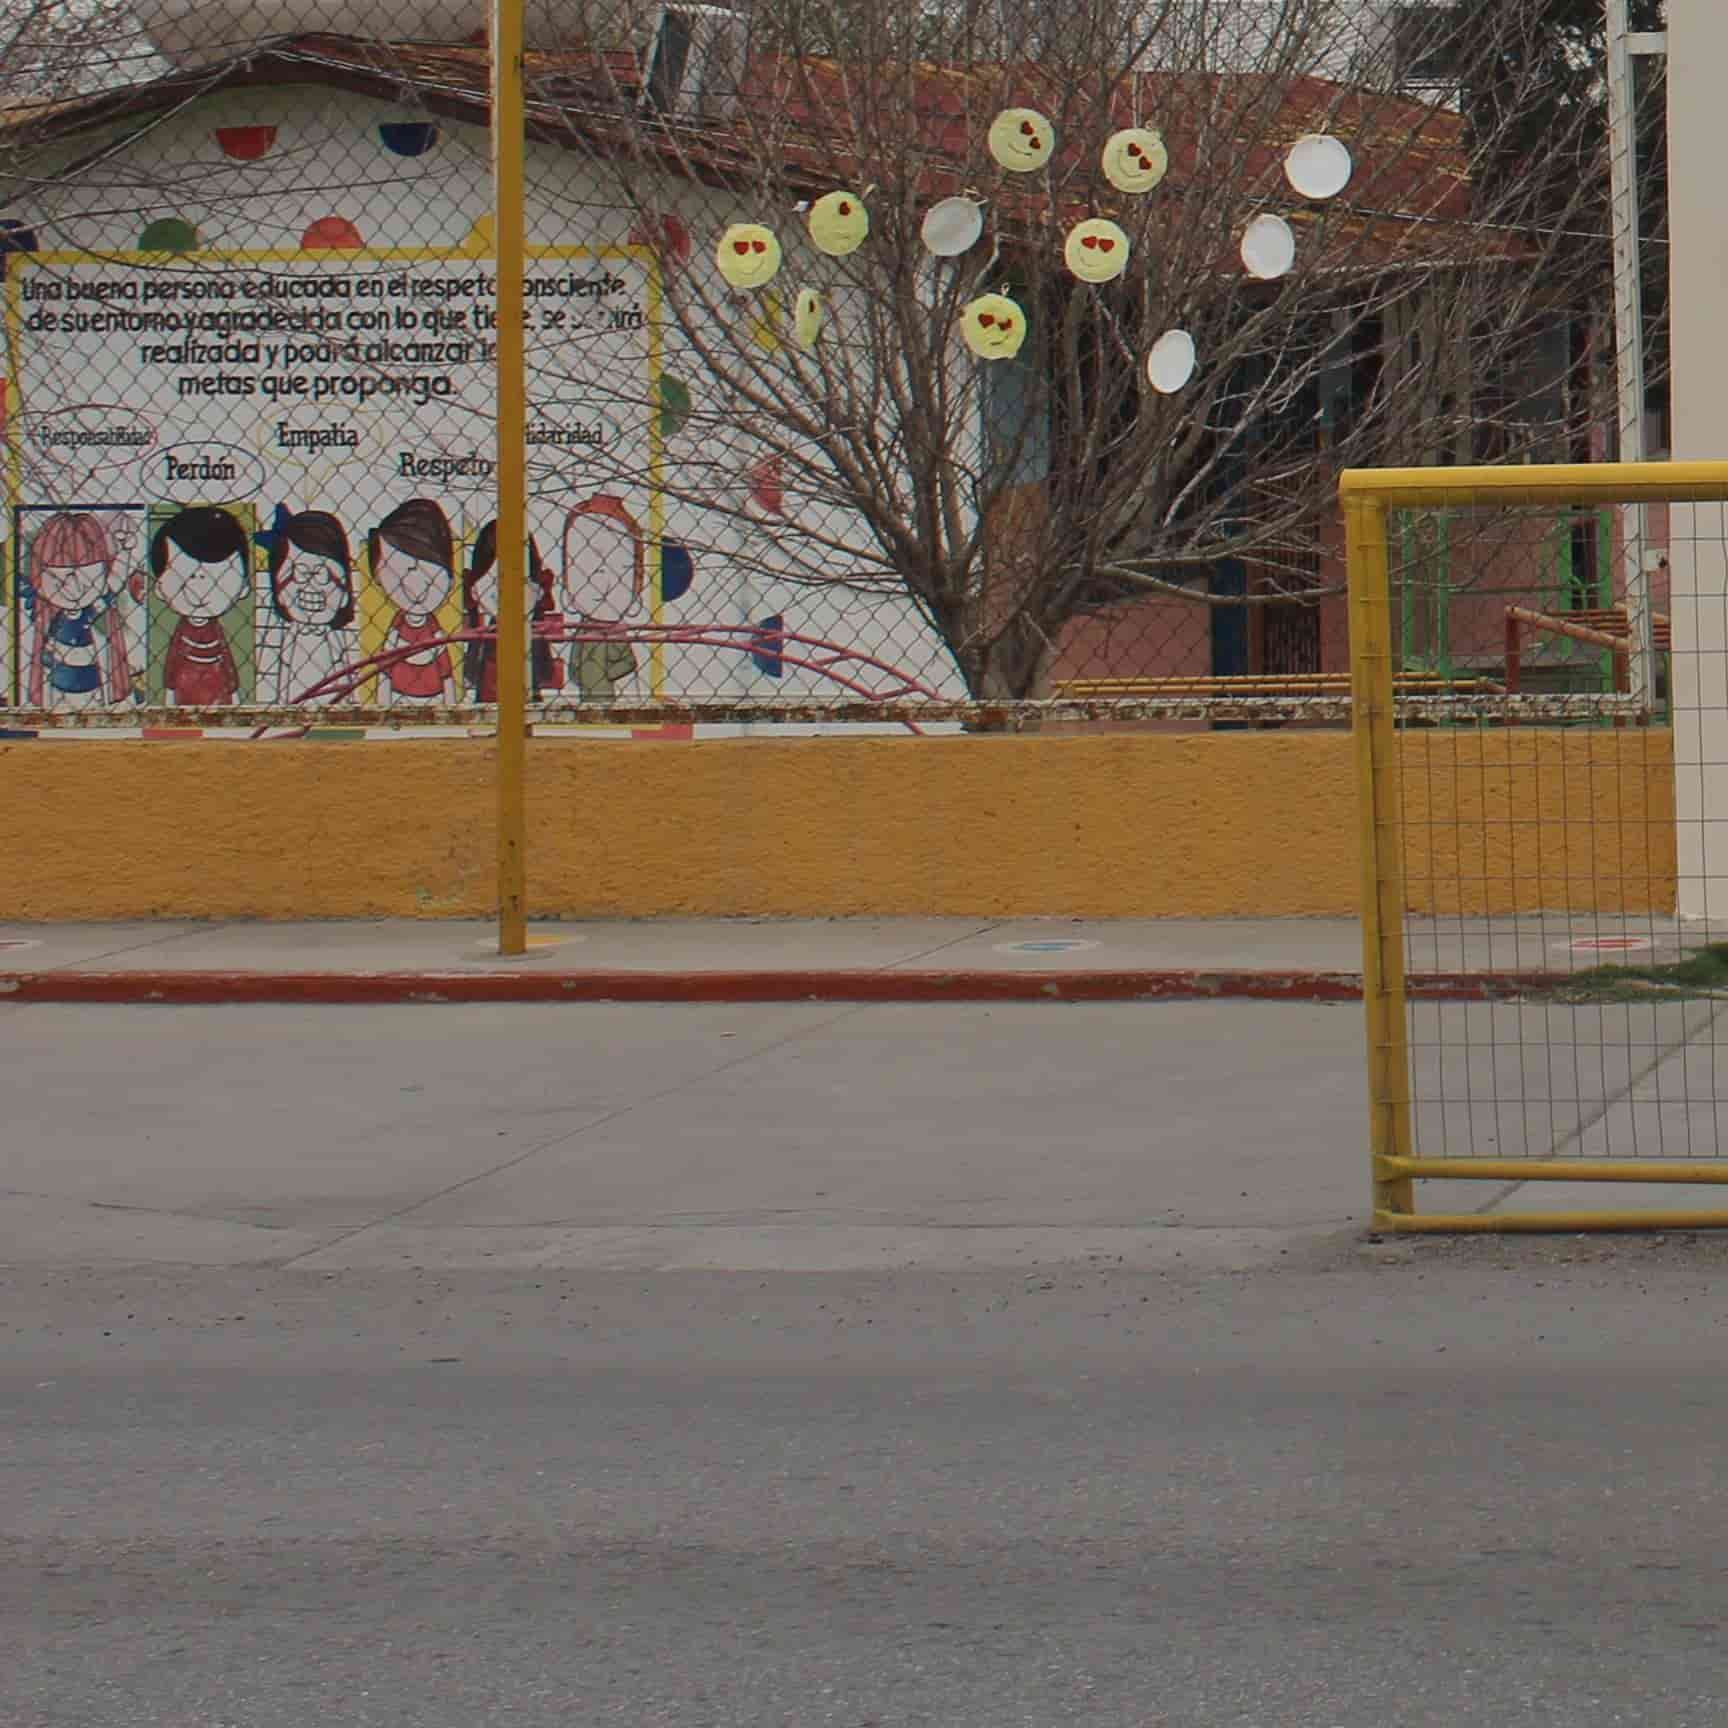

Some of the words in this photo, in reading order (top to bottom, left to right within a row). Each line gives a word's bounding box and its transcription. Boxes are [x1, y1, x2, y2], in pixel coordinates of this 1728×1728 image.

[22, 278, 63, 301] Una
[66, 277, 138, 300] buena
[143, 280, 235, 305] persona
[242, 274, 351, 298] educada
[356, 278, 384, 297] en
[388, 273, 408, 297] el
[28, 306, 58, 332] de
[61, 312, 88, 332] su
[92, 308, 179, 332] entorno
[182, 312, 198, 341] y
[200, 305, 343, 340] agradecida
[347, 310, 391, 330] con
[395, 305, 418, 329] lo
[422, 309, 467, 336] que
[542, 309, 566, 329] se
[141, 338, 260, 364] realizada
[265, 343, 279, 369] y
[366, 338, 472, 363] alcanzar
[178, 375, 253, 396] metas
[263, 377, 309, 402] que
[313, 375, 458, 405] proponga.
[165, 456, 236, 481] Perdón
[399, 450, 493, 482] Respeto
